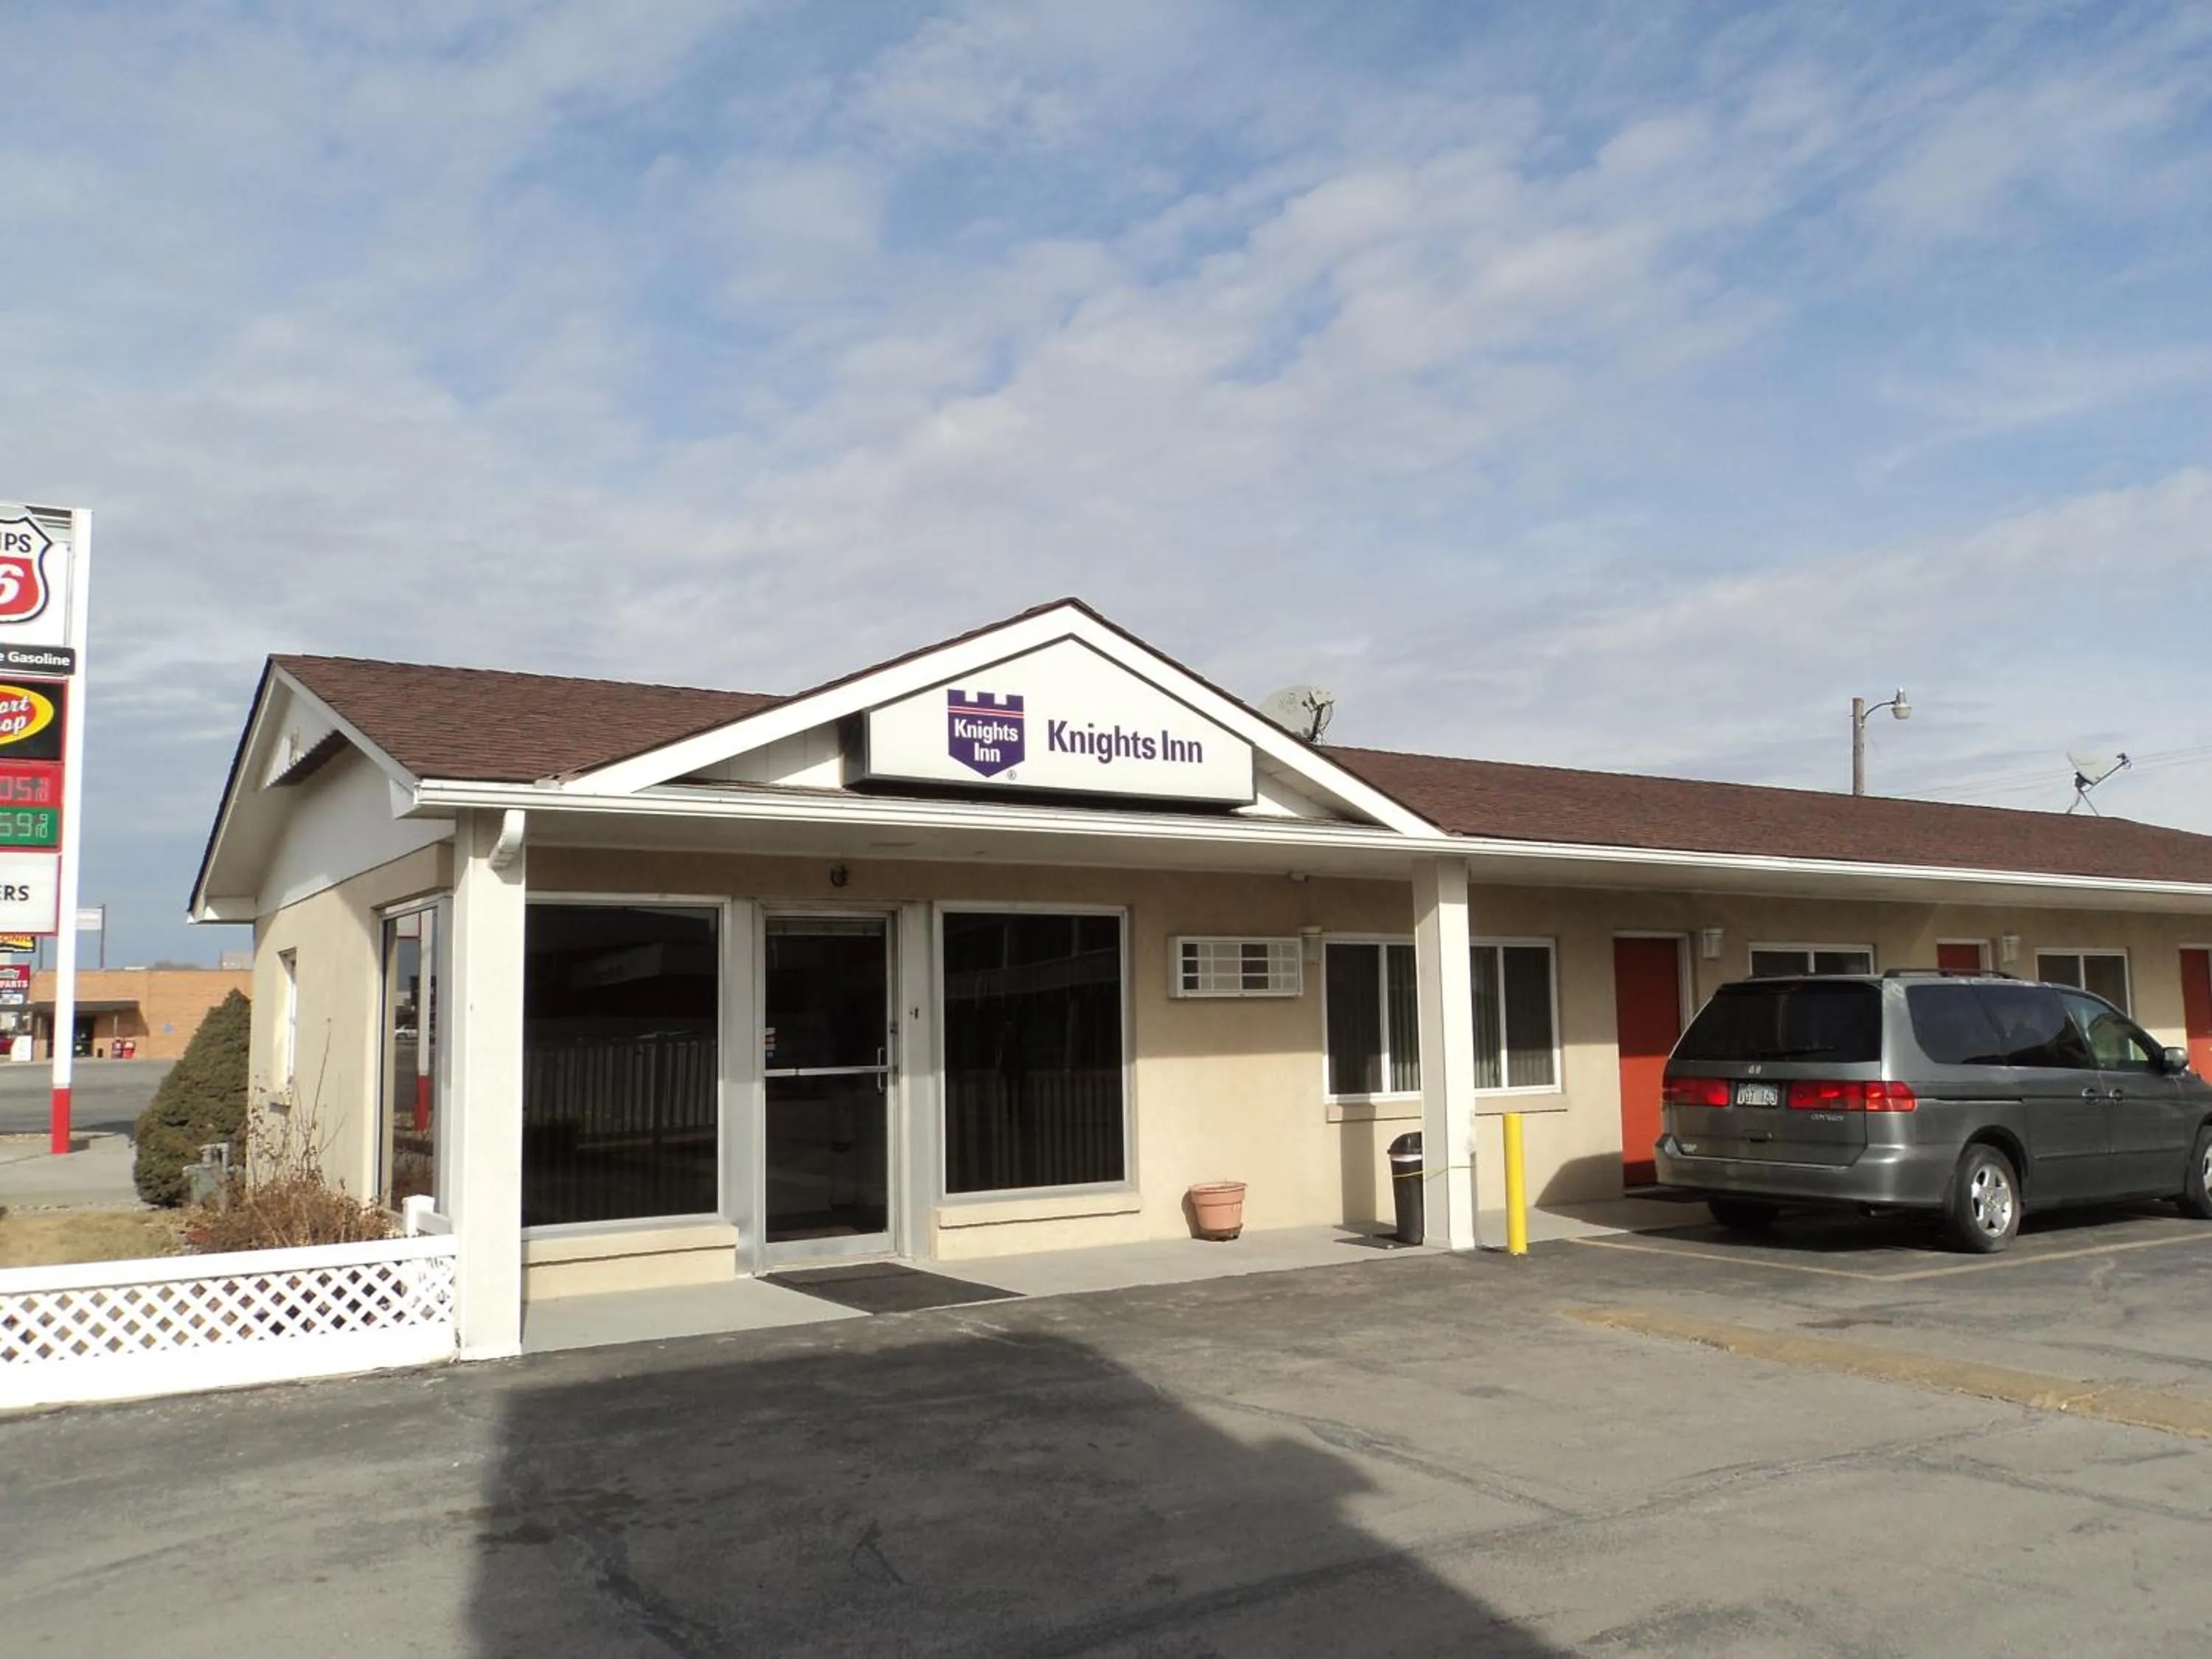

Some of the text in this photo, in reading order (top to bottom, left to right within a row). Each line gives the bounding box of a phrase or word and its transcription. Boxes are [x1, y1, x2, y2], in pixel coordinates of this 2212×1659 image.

[8, 652, 71, 666] Gasoline
[0, 716, 27, 734] op
[955, 718, 1018, 744] Knights
[1048, 719, 1203, 764] Knights Inn
[974, 742, 1001, 762] Inn
[0, 884, 29, 902] RS
